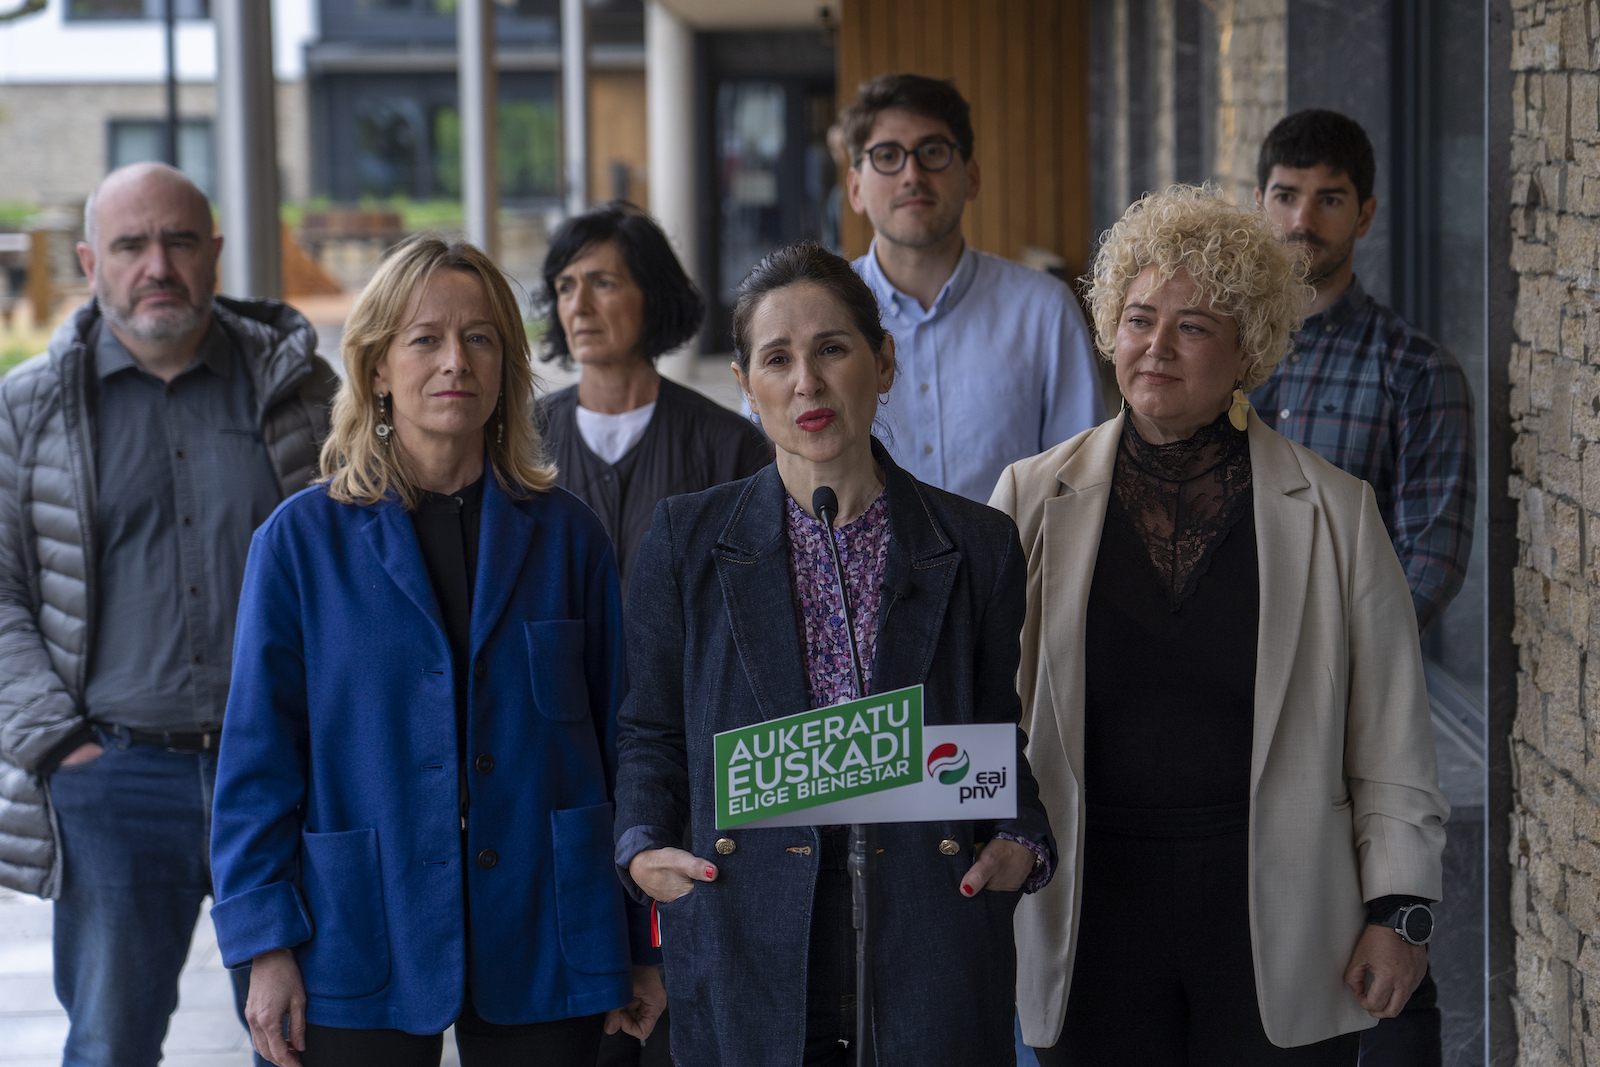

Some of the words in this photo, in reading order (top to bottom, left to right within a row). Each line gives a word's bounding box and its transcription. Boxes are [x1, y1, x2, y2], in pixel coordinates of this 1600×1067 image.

[728, 699, 909, 766] AUKERATU
[728, 727, 910, 798] EUSKADI
[729, 786, 790, 816] ELIGE
[797, 759, 909, 800] BIENESTAR
[975, 766, 1007, 788] eaj
[959, 786, 998, 804] pnv
